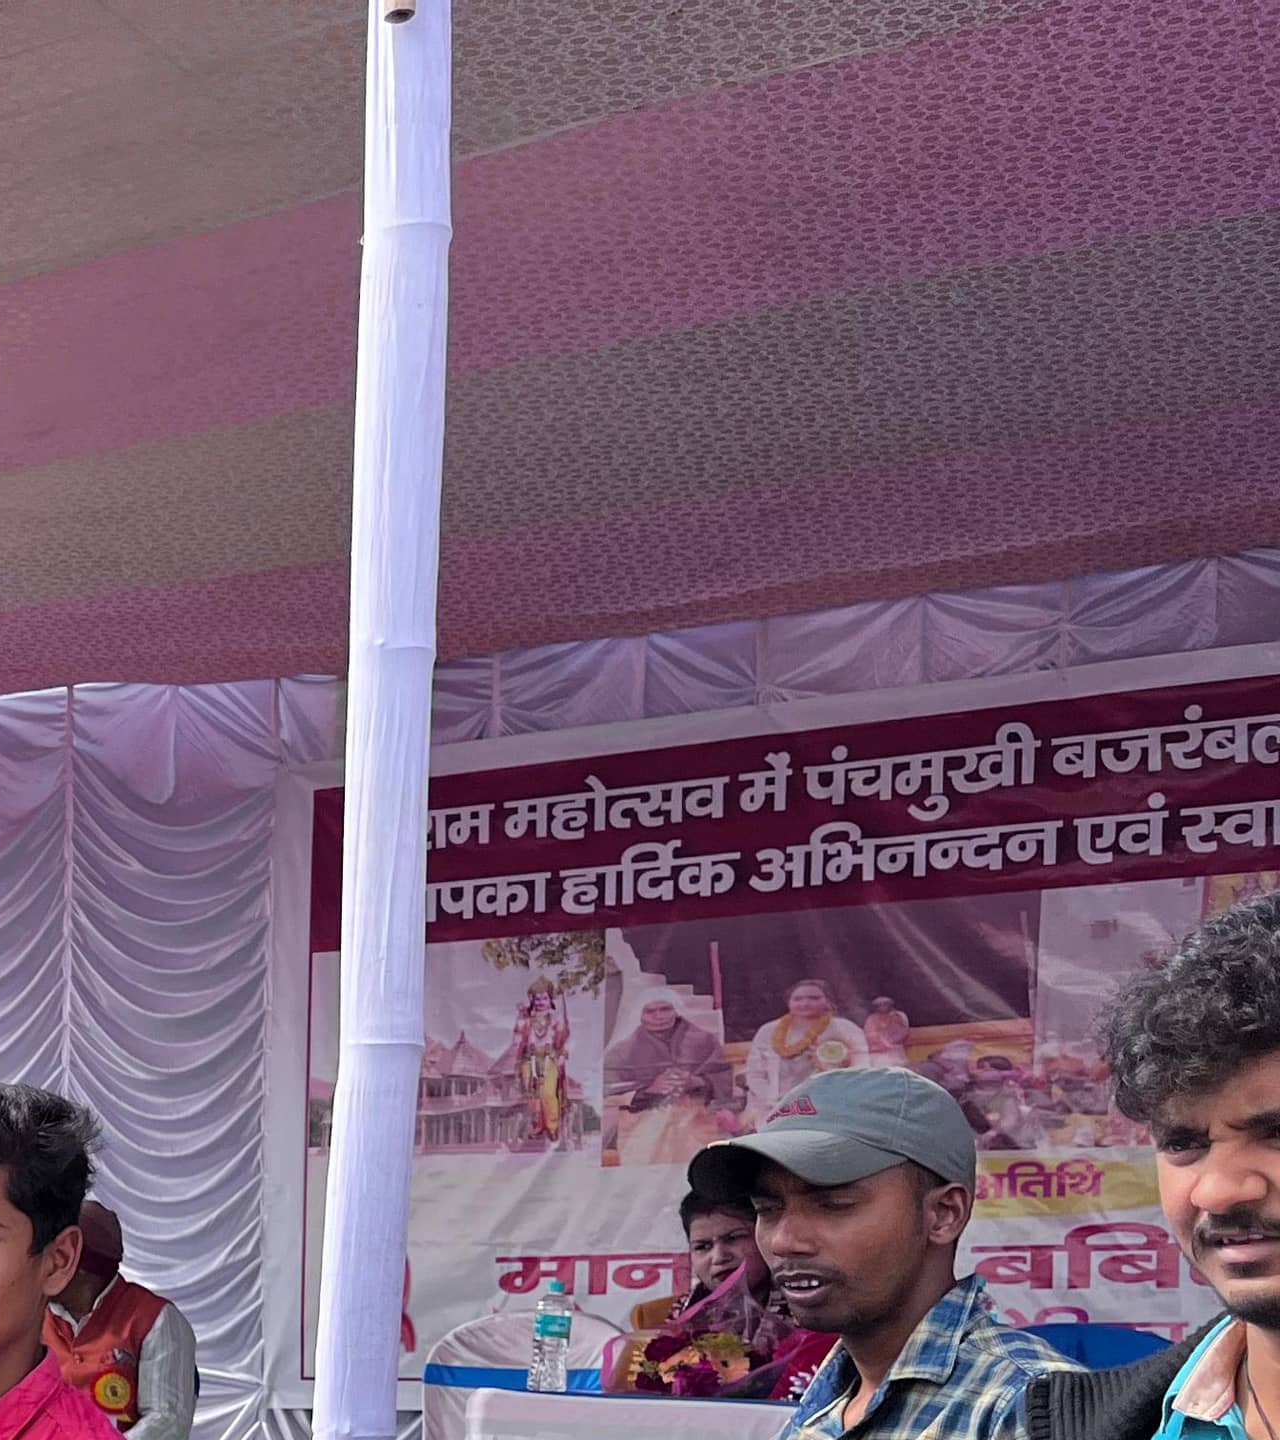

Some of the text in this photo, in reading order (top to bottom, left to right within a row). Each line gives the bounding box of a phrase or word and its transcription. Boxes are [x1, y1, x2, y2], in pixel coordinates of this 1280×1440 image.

[427, 803, 495, 850] ाम
[504, 774, 730, 840] महोत्सव
[738, 751, 793, 813] में
[803, 721, 1041, 822] पंचमुखी
[426, 871, 551, 923] पका
[559, 840, 741, 915] हार्दिक
[749, 820, 1063, 892] अभिनन्दन
[1073, 792, 1169, 865] एवं
[971, 1222, 1216, 1290] बबि
